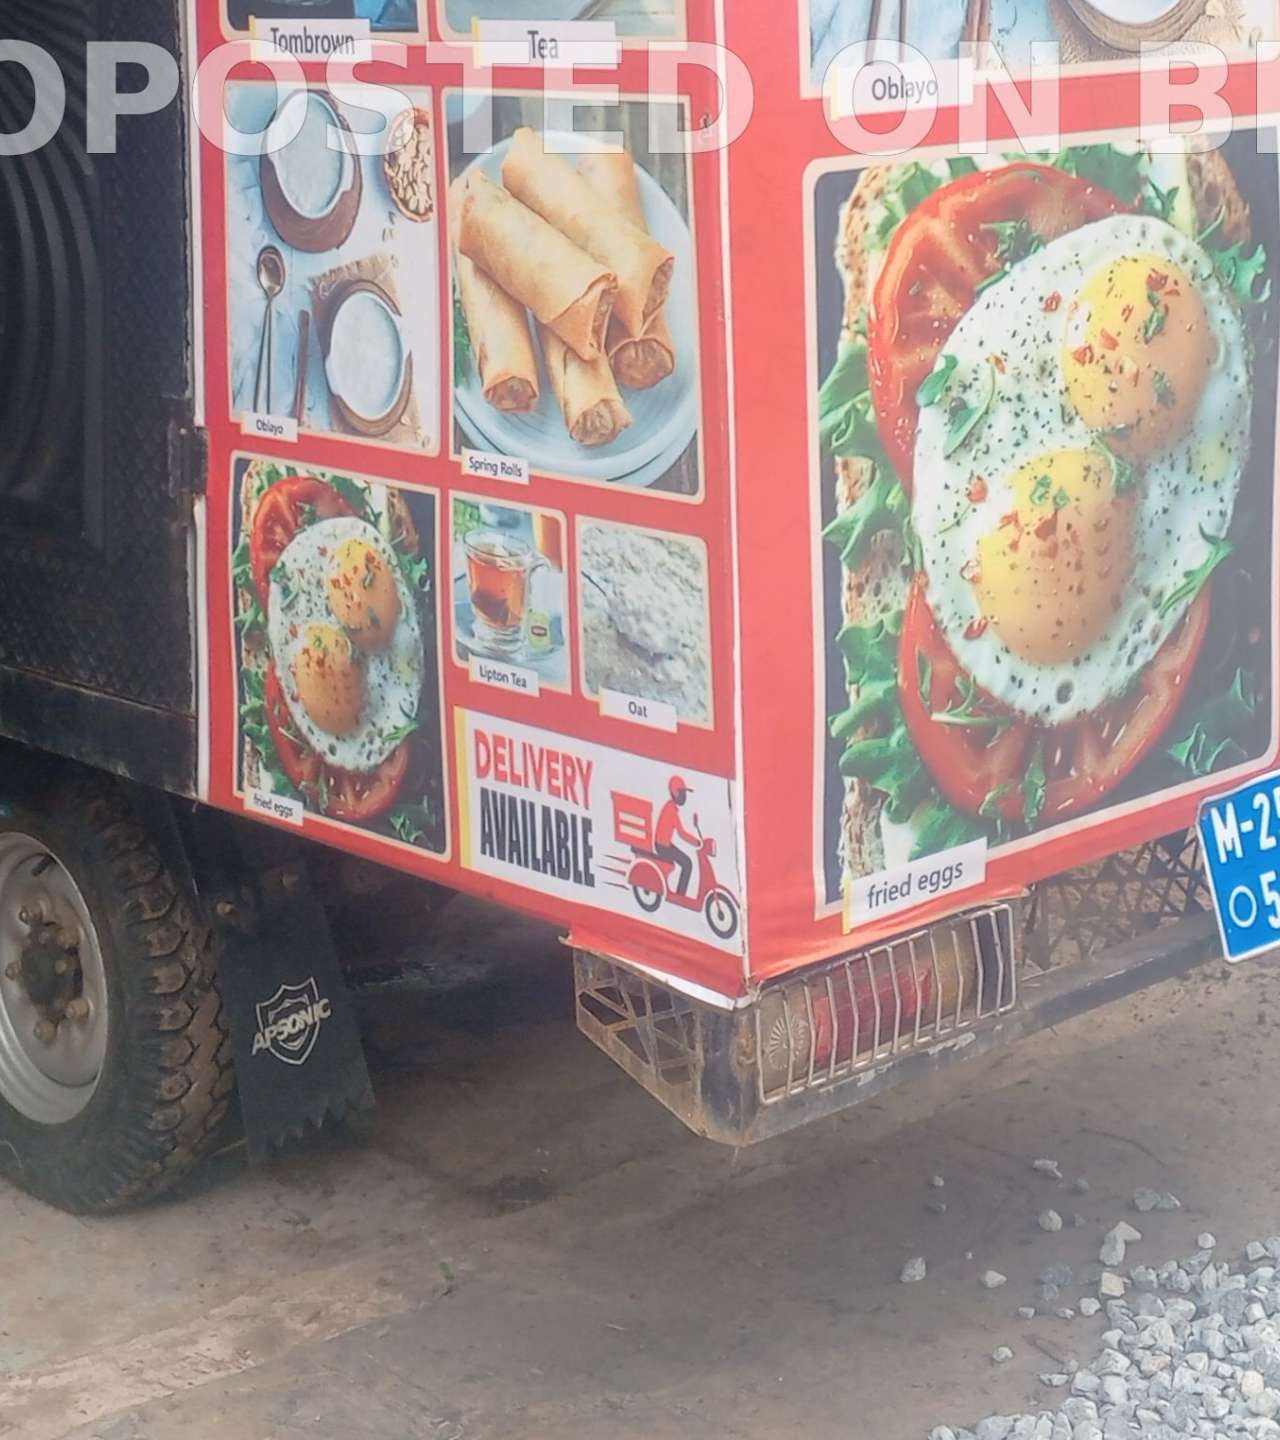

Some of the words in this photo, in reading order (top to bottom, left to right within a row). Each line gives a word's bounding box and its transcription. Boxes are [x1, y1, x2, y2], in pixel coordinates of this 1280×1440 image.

[269, 26, 356, 60] Tombrown
[528, 30, 559, 61] Tea
[871, 73, 938, 103] Oblayo
[469, 455, 499, 477] Spring
[501, 463, 523, 478] Rolls
[479, 664, 509, 684] Lipton
[511, 672, 527, 689] Tea
[628, 700, 648, 718] Oat
[474, 728, 594, 810] DELIVERY
[252, 793, 272, 812] fried
[274, 800, 294, 819] eggs
[480, 787, 596, 888] AVAILABLE
[867, 872, 912, 909] fried
[917, 861, 964, 894] eggs
[252, 998, 332, 1056] APSONIC
